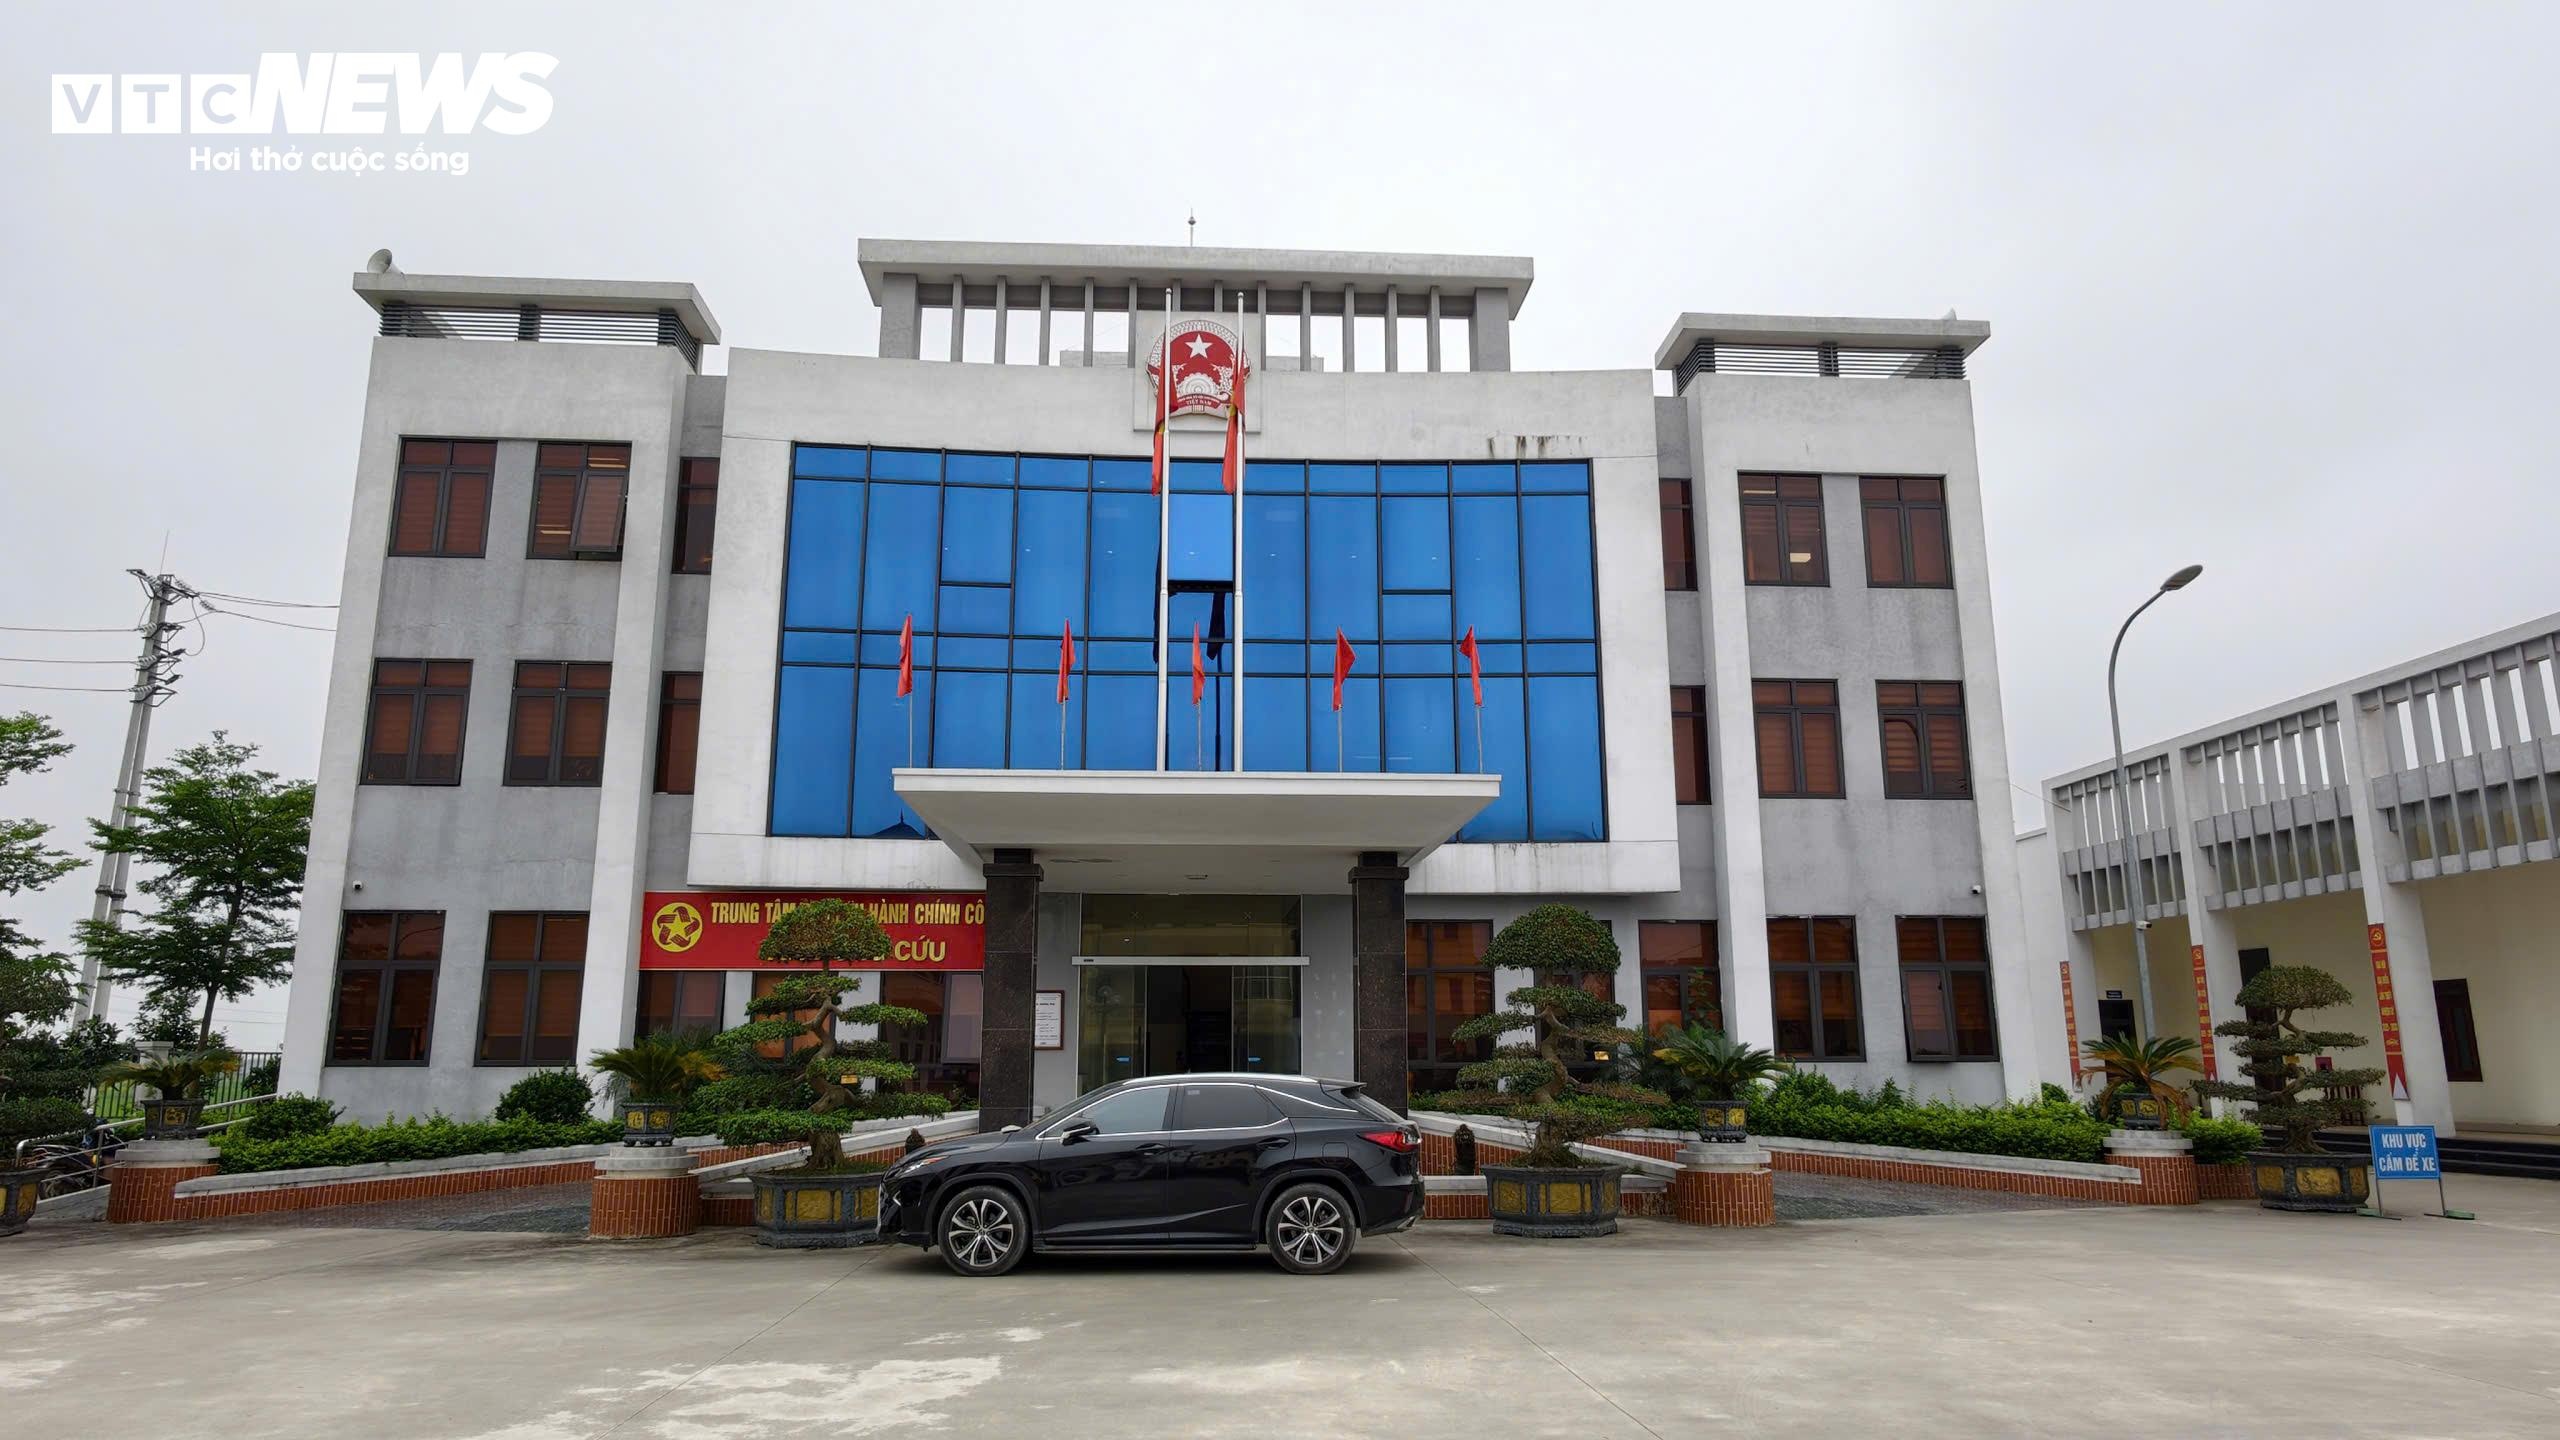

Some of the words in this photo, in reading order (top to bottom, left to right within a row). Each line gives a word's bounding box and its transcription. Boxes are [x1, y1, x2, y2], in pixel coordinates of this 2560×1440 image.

[711, 902, 760, 924] TRUNG
[869, 899, 909, 924] HÀNH
[914, 898, 961, 925] CHÍNH
[964, 898, 985, 925] CÔ
[894, 935, 946, 962] CỨU
[2381, 1133, 2403, 1148] KHU
[2404, 1132, 2426, 1151] VỰC
[2378, 1152, 2403, 1172] CẤM
[2422, 1157, 2437, 1172] XE
